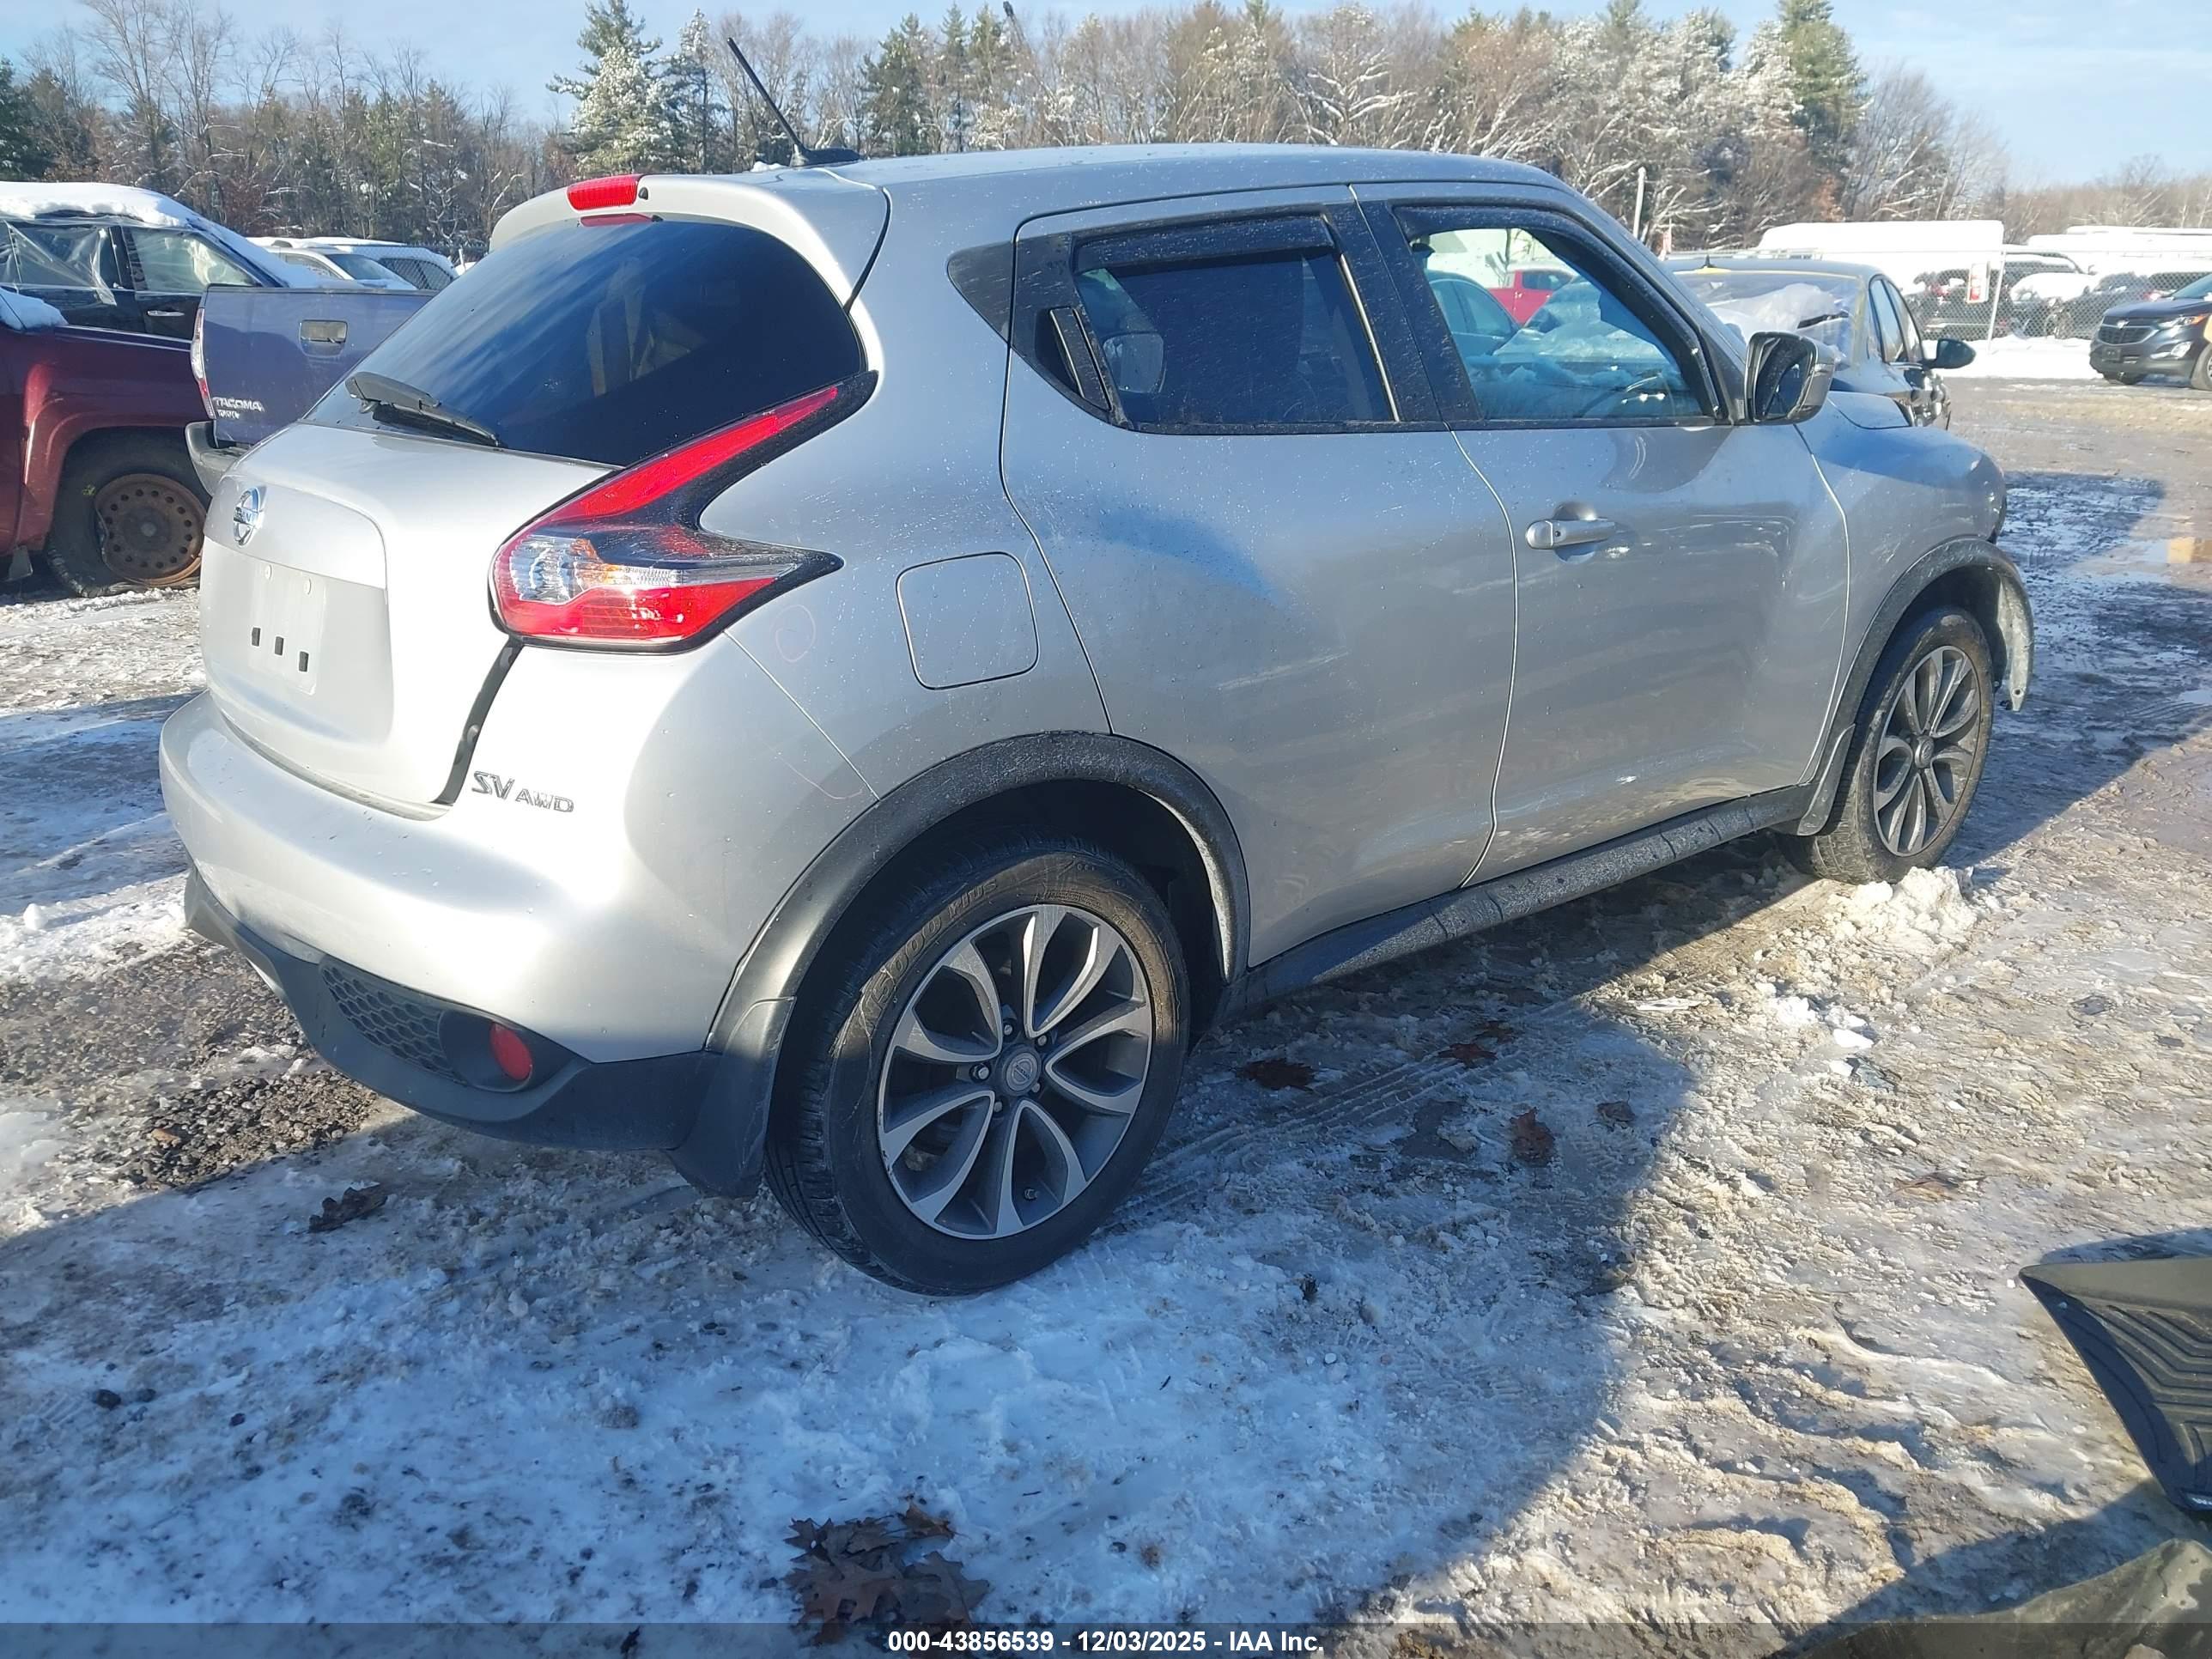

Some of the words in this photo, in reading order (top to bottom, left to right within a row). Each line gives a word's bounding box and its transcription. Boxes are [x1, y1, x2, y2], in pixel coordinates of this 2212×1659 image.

[212, 397, 264, 412] TACOMA
[471, 770, 515, 800] SV
[515, 788, 574, 812] AWD
